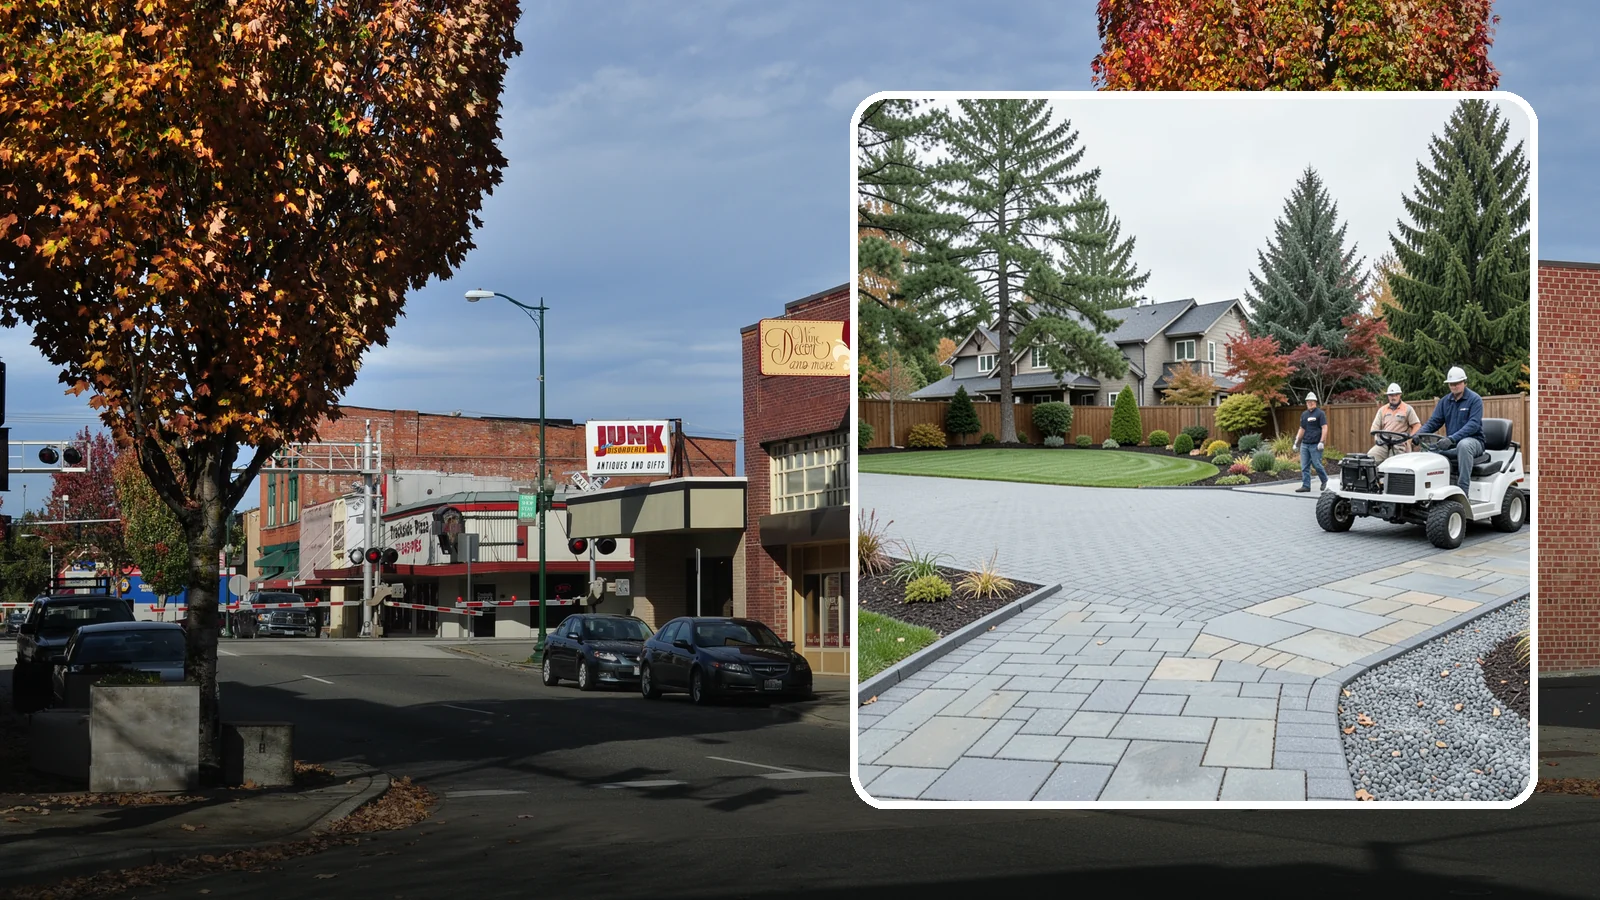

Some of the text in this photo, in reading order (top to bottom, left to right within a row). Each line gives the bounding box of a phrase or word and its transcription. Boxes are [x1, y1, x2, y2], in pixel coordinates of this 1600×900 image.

[595, 425, 665, 457] JUNK
[608, 446, 646, 454] DISORDERLY
[597, 460, 666, 470] ANTIQUES AND GIFTS
[414, 520, 429, 534] Pizza
